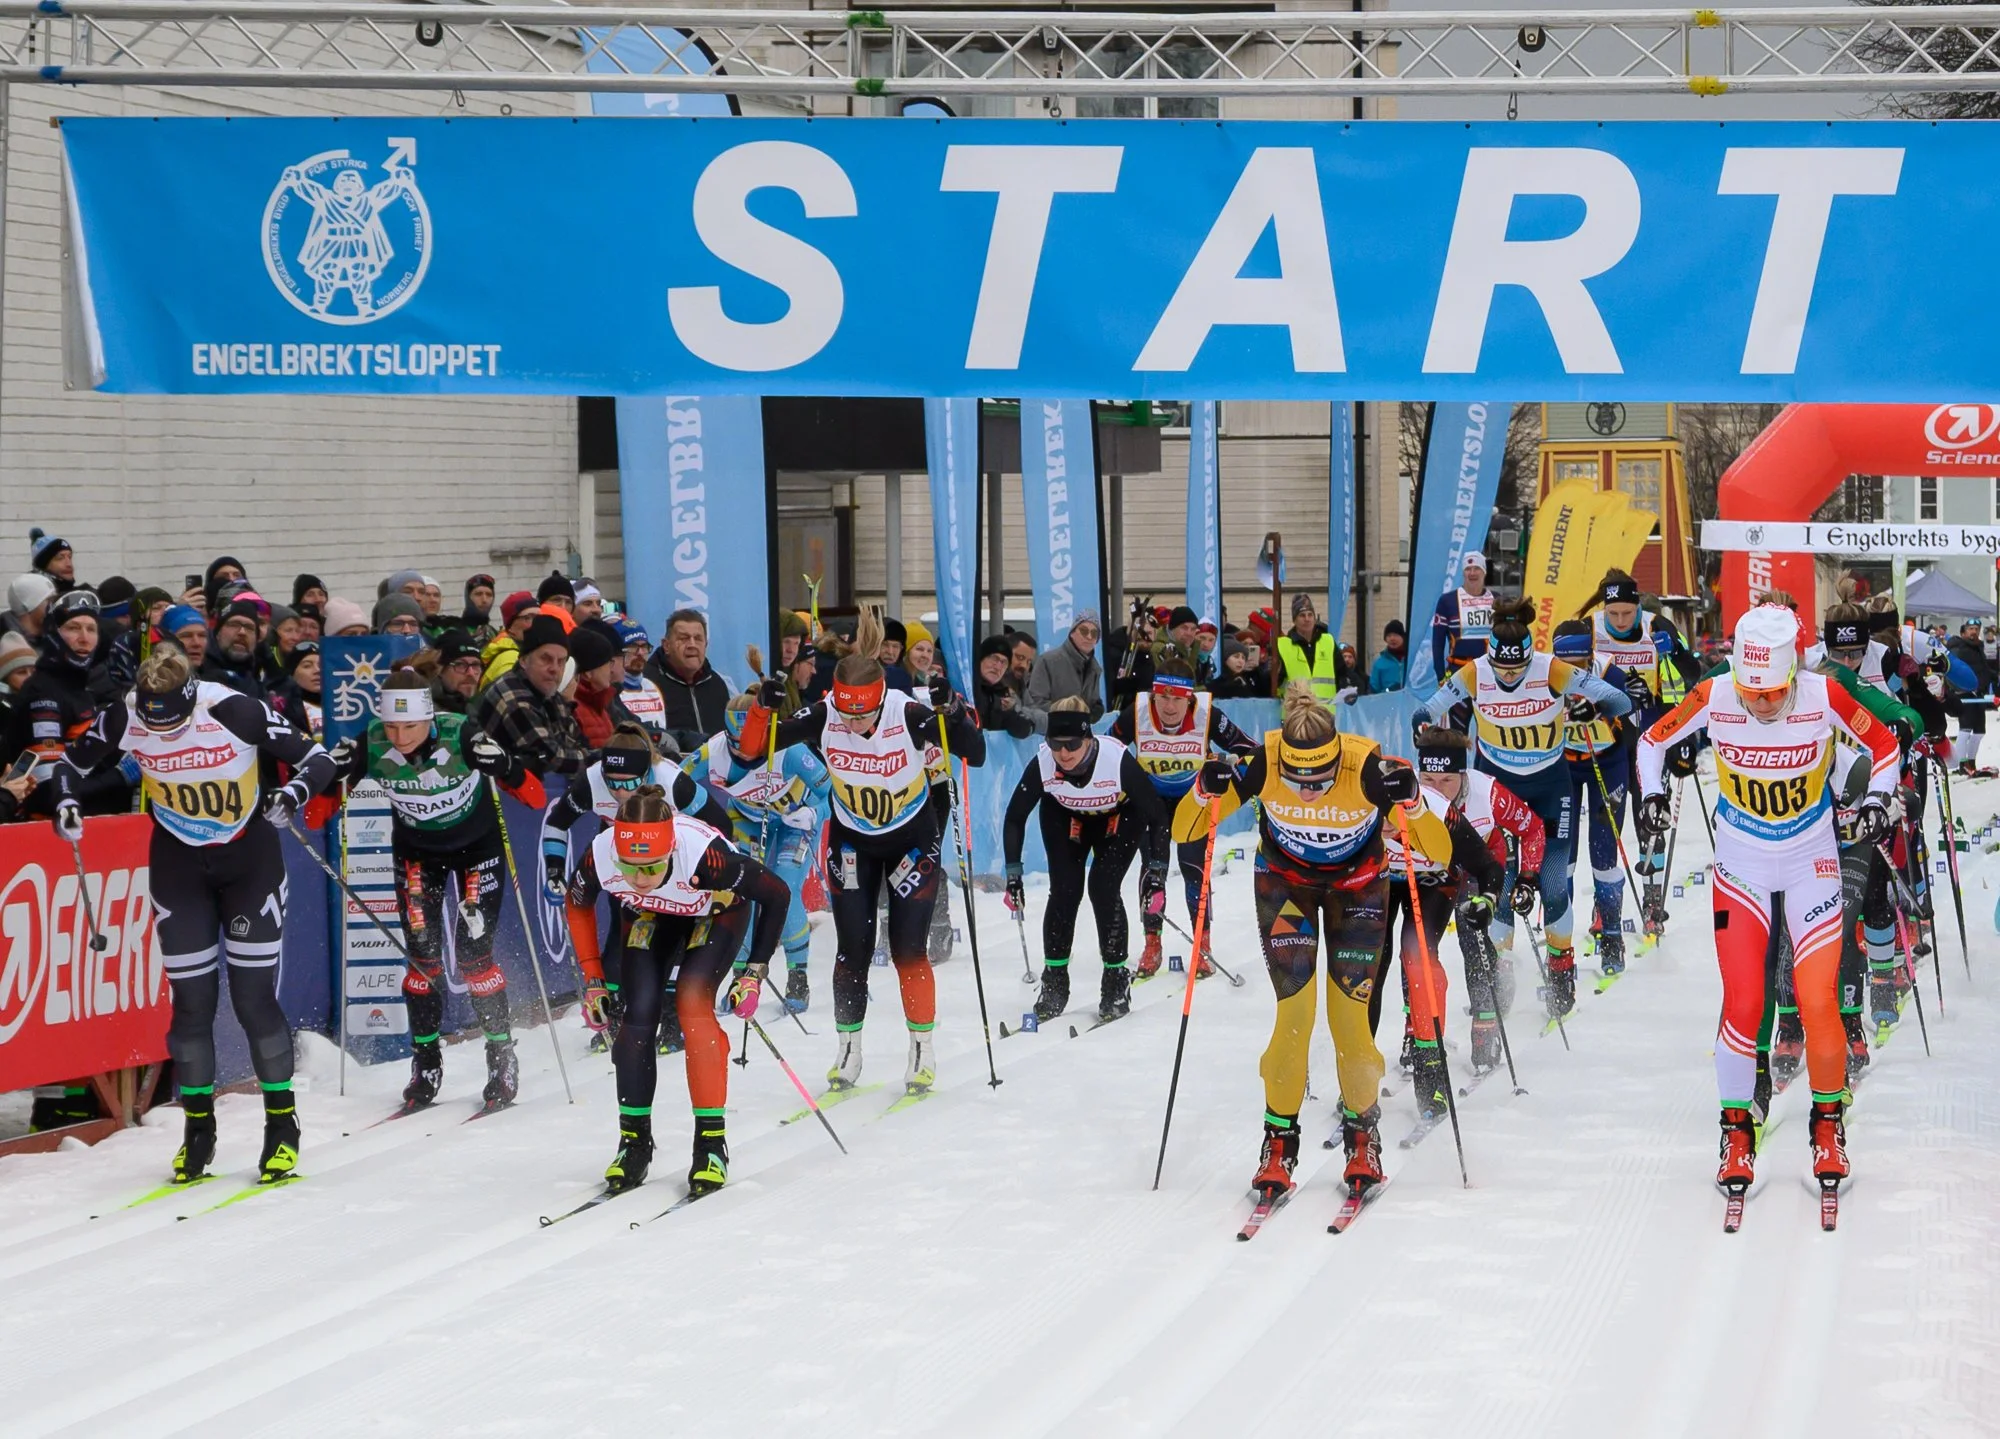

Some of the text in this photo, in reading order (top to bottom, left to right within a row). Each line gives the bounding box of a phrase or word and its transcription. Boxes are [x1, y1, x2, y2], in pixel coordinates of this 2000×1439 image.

[276, 194, 289, 220] BYGD
[307, 162, 328, 177] FÖR
[330, 158, 368, 170] STYRKA
[401, 190, 416, 213] OCH
[411, 216, 423, 253] FRIHET
[668, 140, 1905, 374] START
[375, 271, 413, 308] NORBERG
[192, 343, 500, 377] ENGELBREKTSLOPPET
[1544, 504, 1573, 586] RAMIRENT
[1803, 525, 2000, 555] I Engelbrekts byg
[1836, 626, 1857, 636] XC
[1500, 645, 1520, 655] XC
[1495, 720, 1557, 750] 1017
[157, 748, 232, 772] ENERVIT
[1153, 743, 1200, 754] ENERVIT
[1291, 752, 1328, 762] Ramudden
[1743, 744, 1817, 766] ENERVIT
[852, 752, 905, 775] ENERVIT
[1422, 756, 1450, 766] EKSJÖ
[158, 781, 243, 822] 1004
[842, 784, 910, 826] 1007
[1729, 773, 1808, 817] 1003
[1269, 801, 1369, 823] brandfast
[1804, 892, 1840, 923] CRAFT
[350, 940, 397, 949] VAUHT
[357, 973, 396, 988] ALPE
[1026, 1018, 1033, 1029] 2
